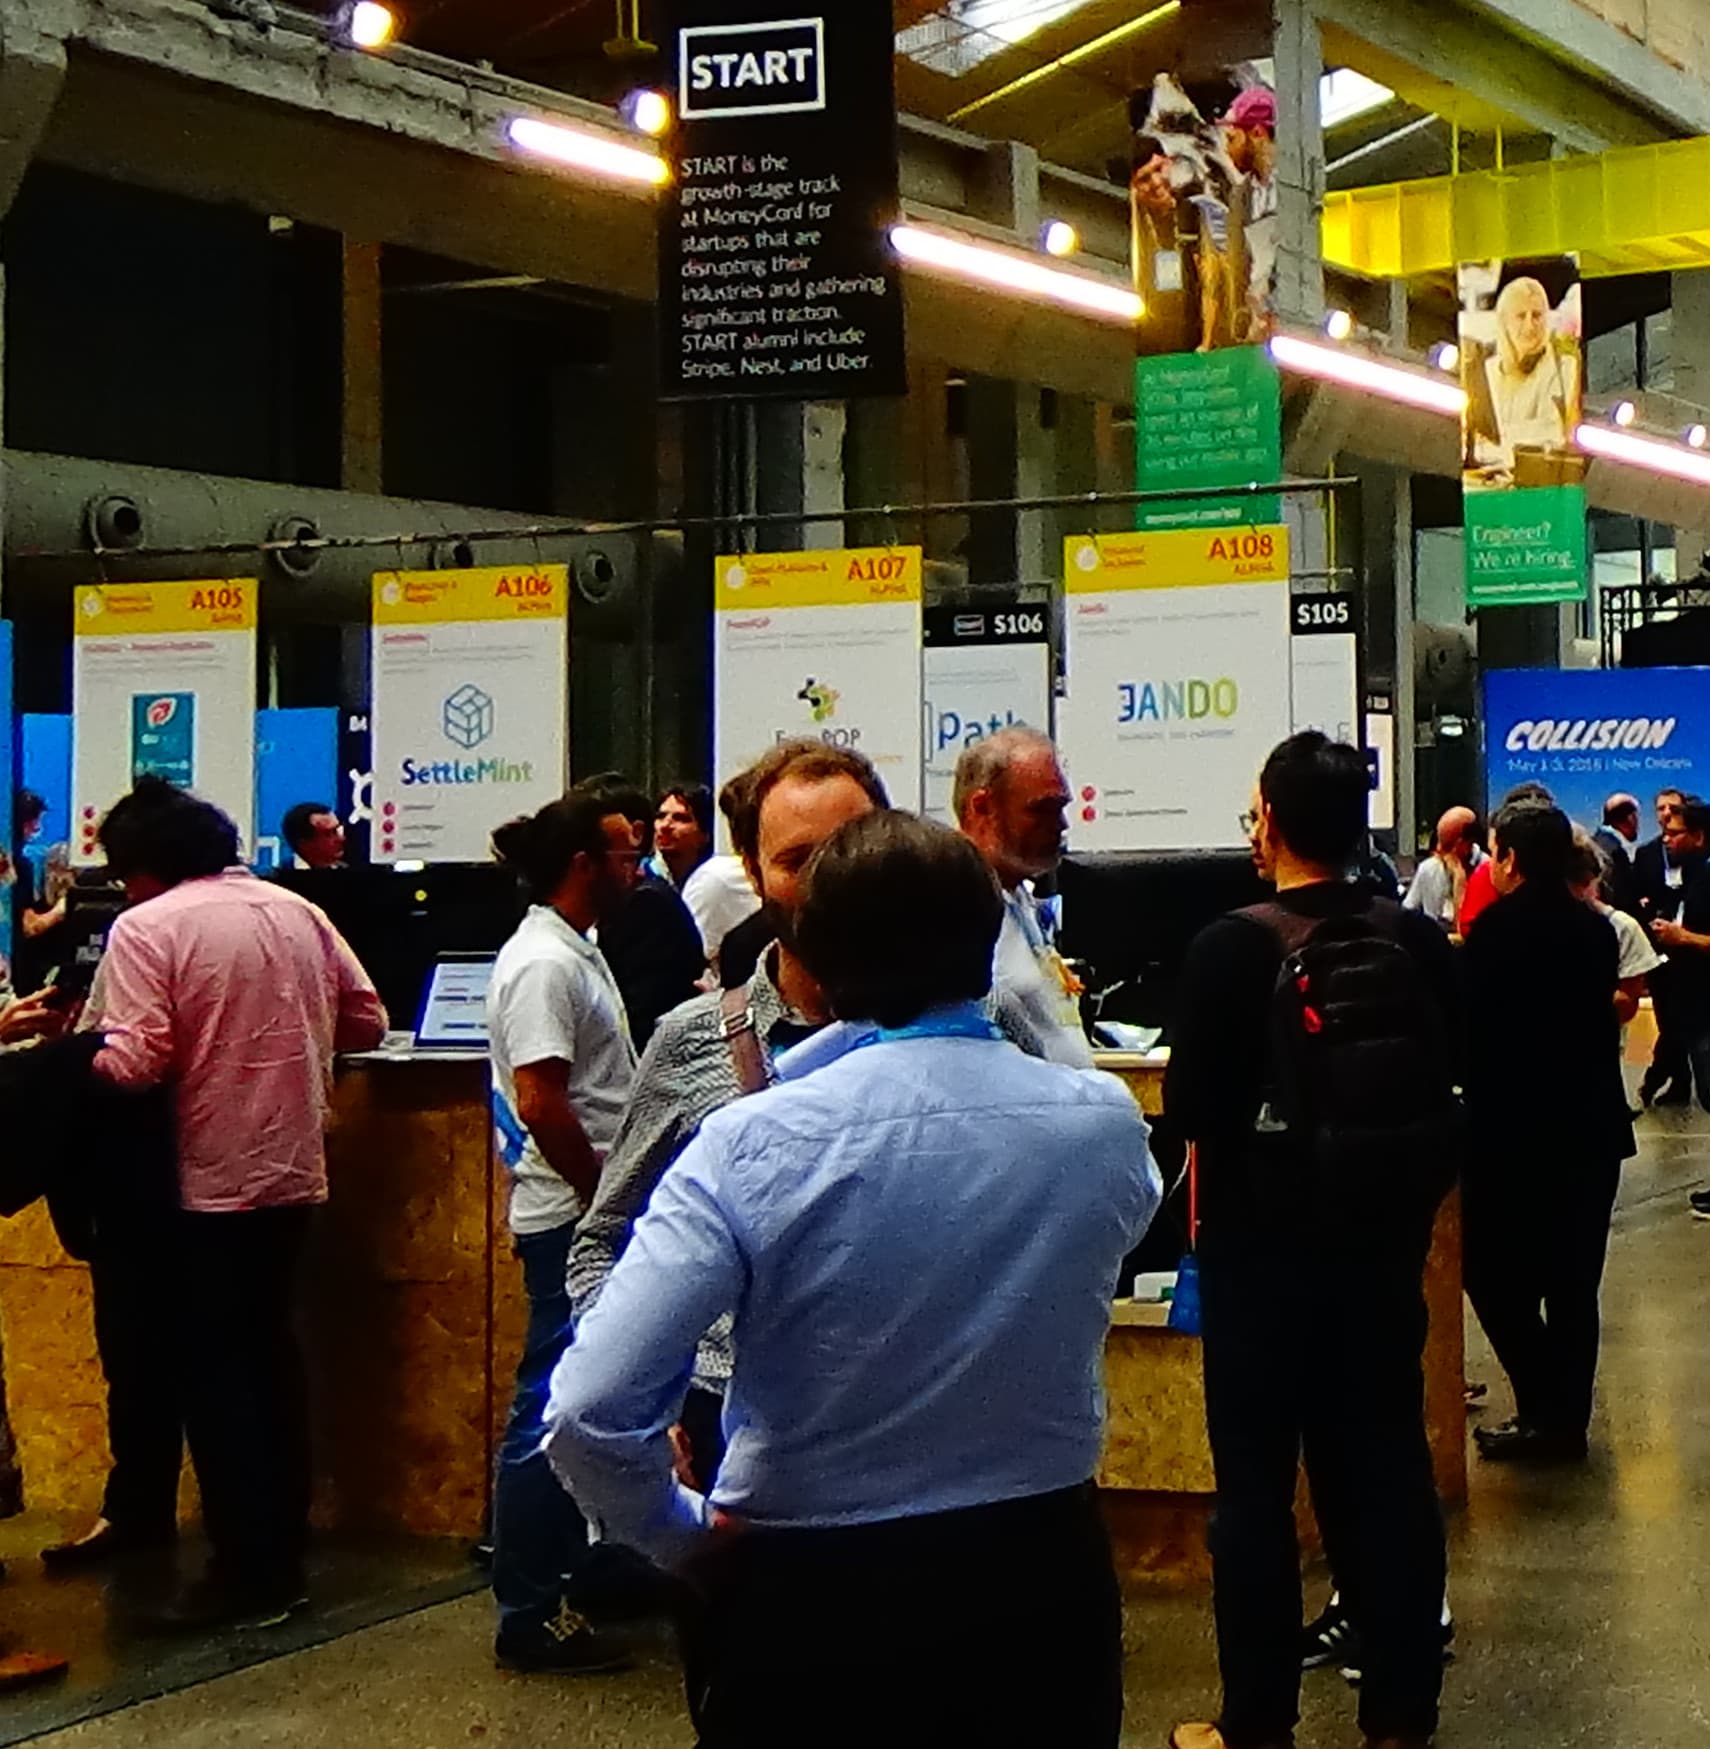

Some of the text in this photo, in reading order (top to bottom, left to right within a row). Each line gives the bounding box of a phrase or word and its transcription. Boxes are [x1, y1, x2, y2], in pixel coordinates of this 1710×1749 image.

[691, 47, 813, 90] START
[681, 153, 789, 177] START is the
[681, 174, 841, 206] growth-stage track
[680, 202, 833, 228] at MoneyConf for
[681, 230, 822, 252] startups that are
[681, 252, 811, 278] disrupting their
[681, 273, 887, 302] industries and gathering
[681, 307, 766, 330] significant
[681, 326, 867, 353] START alumni include
[789, 354, 822, 372] and
[1209, 534, 1274, 561] A108
[847, 556, 908, 581] A107
[495, 574, 553, 598] A106
[191, 587, 243, 611] A105
[993, 613, 1044, 635] S106
[1298, 602, 1349, 626] S105
[1505, 717, 1676, 752] COLLISION
[401, 756, 533, 786] SettleMint
